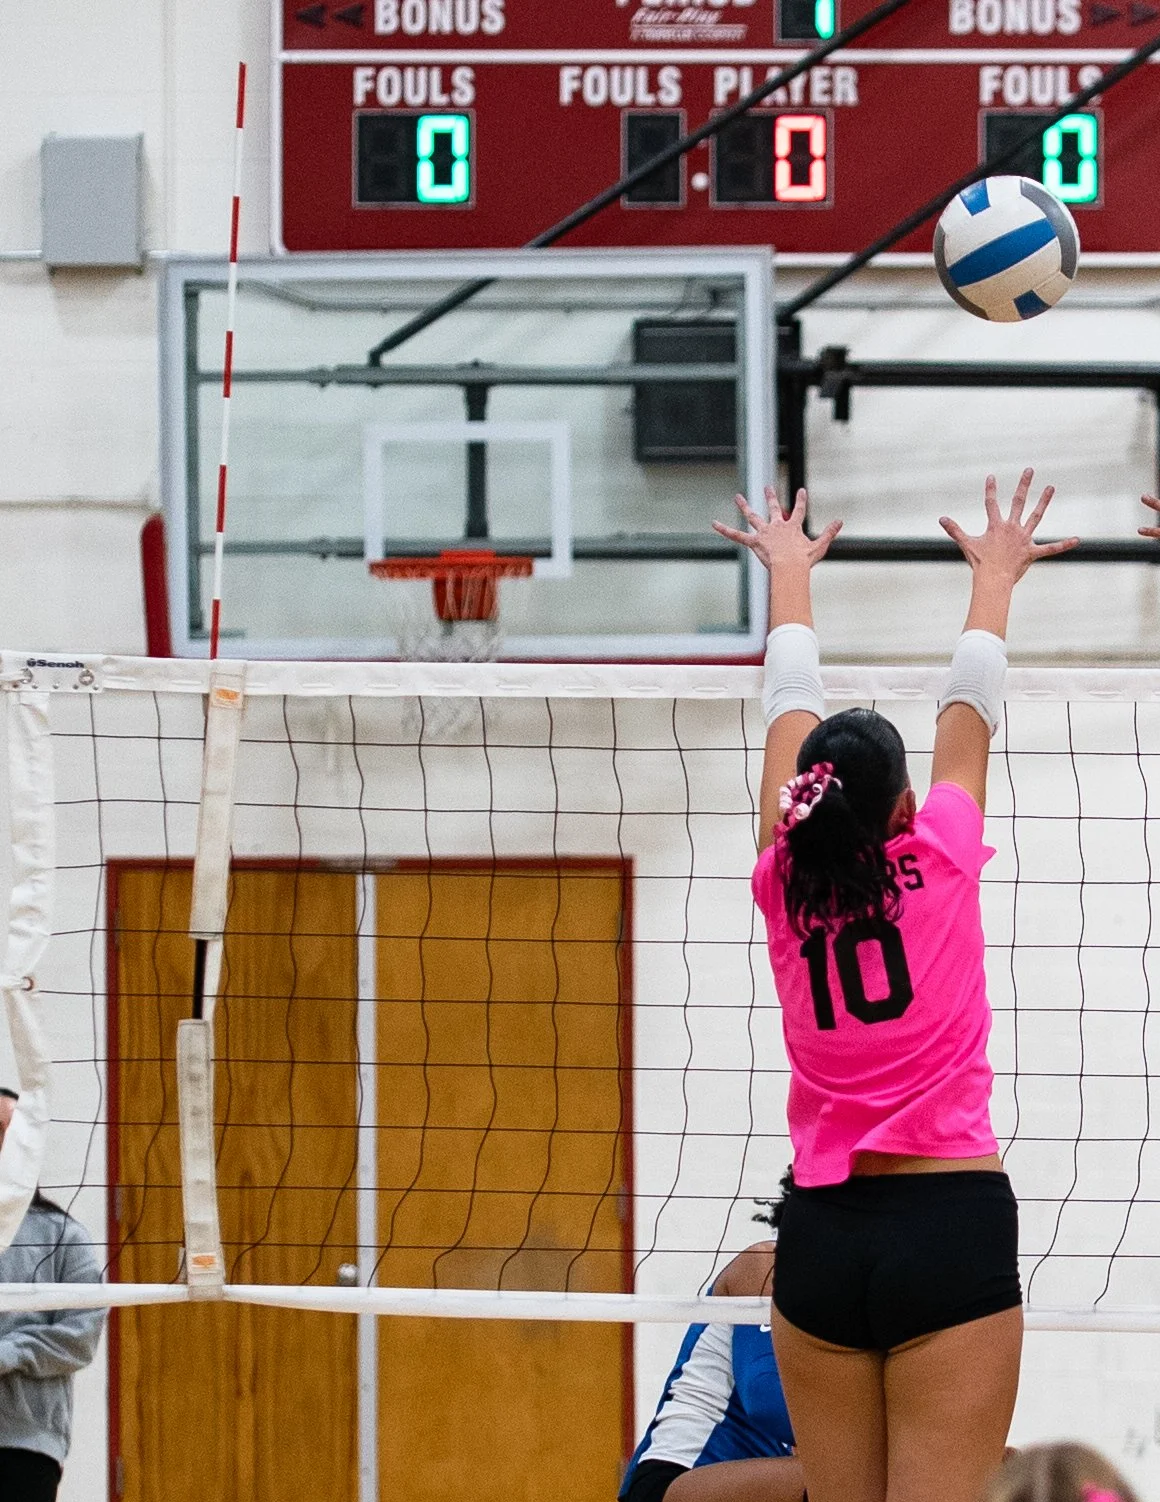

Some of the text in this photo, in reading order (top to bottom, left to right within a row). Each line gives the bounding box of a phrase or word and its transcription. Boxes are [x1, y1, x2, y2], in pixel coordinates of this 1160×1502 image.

[374, 0, 506, 36] BONUS
[949, 0, 1082, 36] BONUS
[353, 65, 476, 107] FOULS
[558, 65, 859, 107] FOULS PLAYER
[417, 115, 470, 204] 0
[775, 114, 827, 202] 0
[1043, 113, 1098, 204] 0
[36, 659, 85, 669] Senoh
[800, 915, 915, 1031] 10
